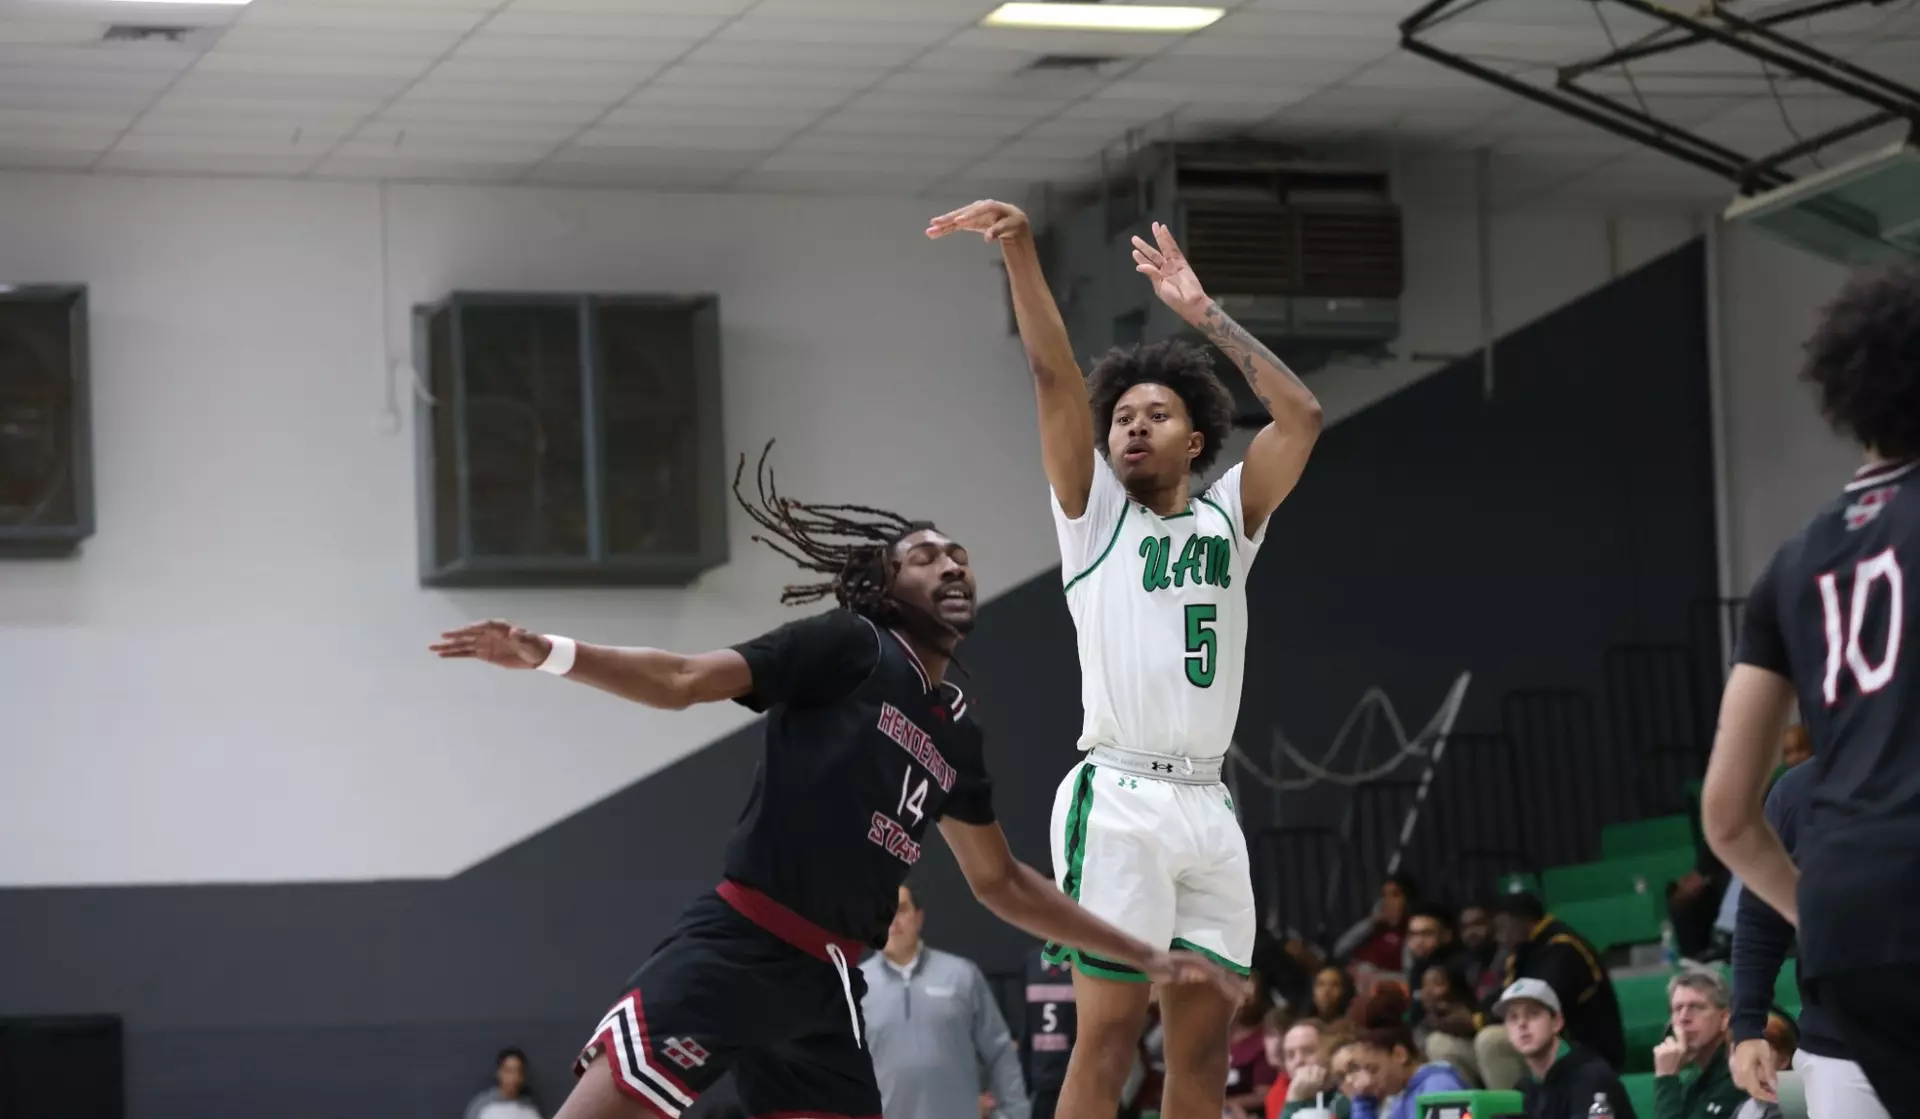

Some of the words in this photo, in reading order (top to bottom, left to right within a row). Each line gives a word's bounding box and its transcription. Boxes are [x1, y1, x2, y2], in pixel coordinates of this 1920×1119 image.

[1139, 533, 1231, 592] UAM
[1184, 603, 1217, 688] 5
[1814, 545, 1903, 708] 10
[897, 764, 928, 828] 14
[1042, 1002, 1057, 1032] 5
